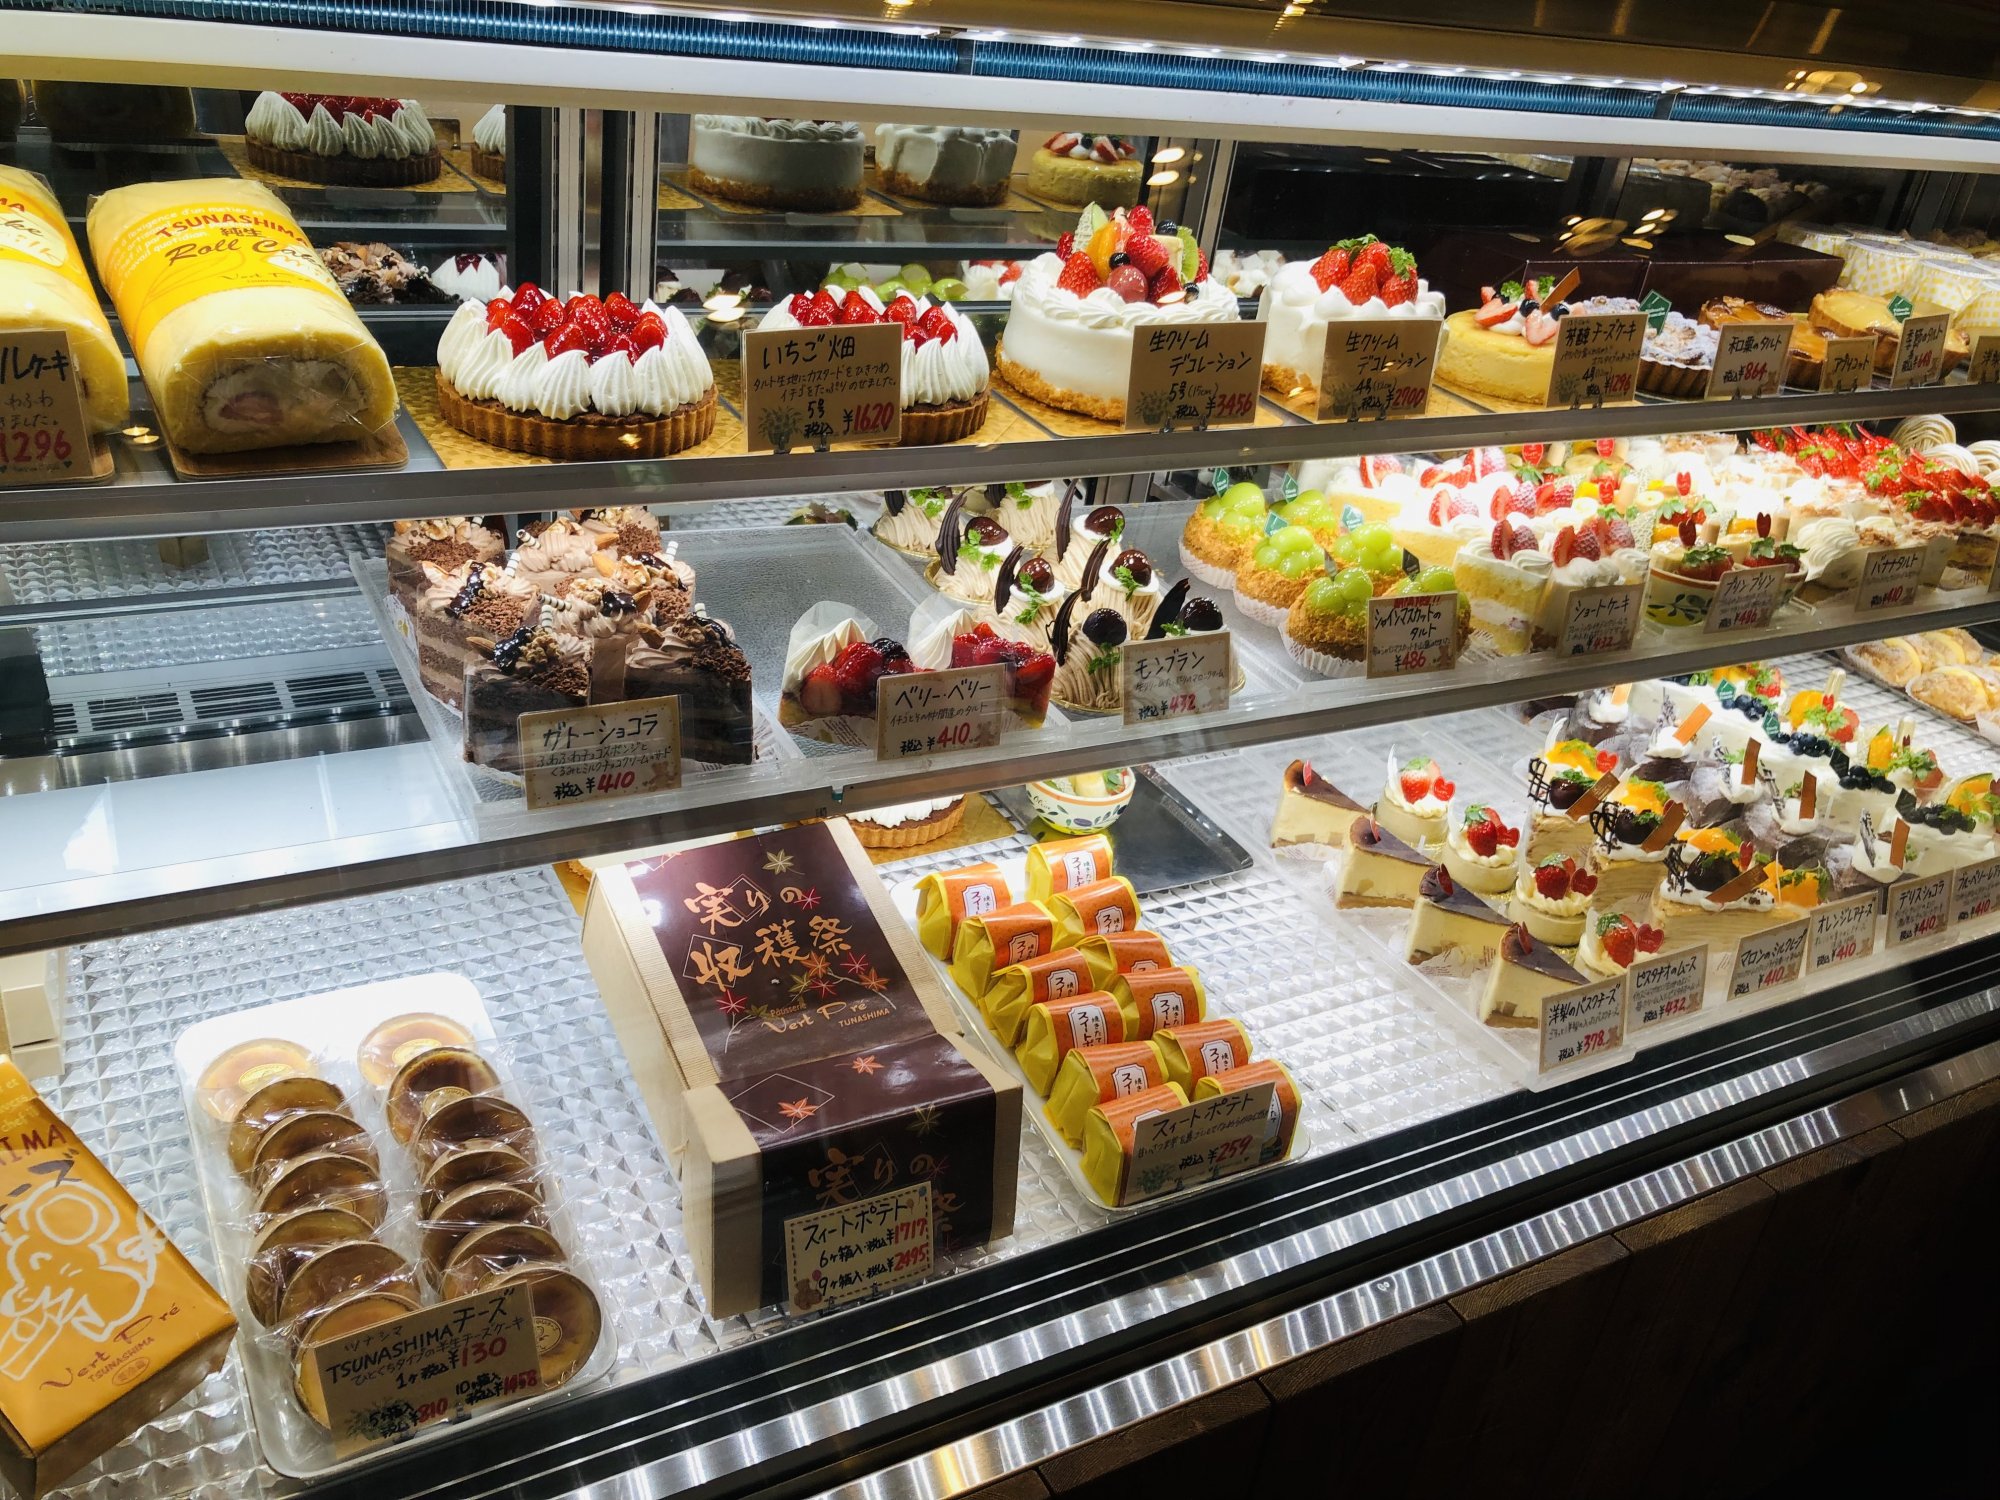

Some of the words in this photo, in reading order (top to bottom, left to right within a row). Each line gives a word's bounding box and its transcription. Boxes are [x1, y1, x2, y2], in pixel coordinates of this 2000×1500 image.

[165, 238, 242, 267] Roll
[763, 333, 855, 370] いちご畑
[1149, 329, 1209, 353] 生クリーム
[1346, 331, 1399, 352] 生クリーム
[1169, 351, 1252, 377] デコレーション
[1169, 381, 1187, 402] 5号
[1174, 404, 1200, 419] 税込
[1205, 392, 1254, 417] ¥3456
[804, 423, 834, 439] 税込
[843, 402, 895, 434] ¥1620
[807, 398, 825, 419] 5号
[1871, 553, 1919, 576] バナナタルト
[1375, 604, 1441, 630] シャインマスカットの
[1574, 594, 1630, 622] ショートケーキ
[1410, 623, 1437, 641] タルト
[1135, 648, 1205, 680] モンブラン
[1395, 650, 1426, 672] ¥486
[1138, 705, 1159, 720] 税込
[543, 713, 659, 752] ガトーショコラ
[900, 739, 923, 755] 税込
[927, 722, 971, 750] ¥410
[553, 782, 584, 800] 税込
[586, 770, 636, 793] ¥410
[683, 882, 803, 935] 実りの
[1914, 915, 1936, 936] ¥410
[689, 915, 853, 992] 収穫祭
[1831, 942, 1857, 962] ¥410
[1636, 956, 1697, 988] ピスタチオのムース
[1757, 966, 1785, 989] ¥410
[761, 1012, 815, 1034] Vert
[816, 999, 869, 1020] Pré
[838, 1007, 891, 1028] TUNASHIMA
[1548, 983, 1621, 1026] 洋梨のバスクチーズ
[1659, 997, 1686, 1019] ¥432
[1558, 1047, 1575, 1061] 税込
[1576, 1029, 1605, 1054] ¥378
[1179, 1154, 1204, 1170] 税込
[1208, 1134, 1254, 1165] ¥259
[887, 1217, 928, 1245] ¥1717
[39, 1351, 111, 1391] Vert
[113, 1302, 181, 1345] Pré
[88, 1336, 156, 1383] TSUNASHIMA
[448, 1337, 508, 1369] ¥130
